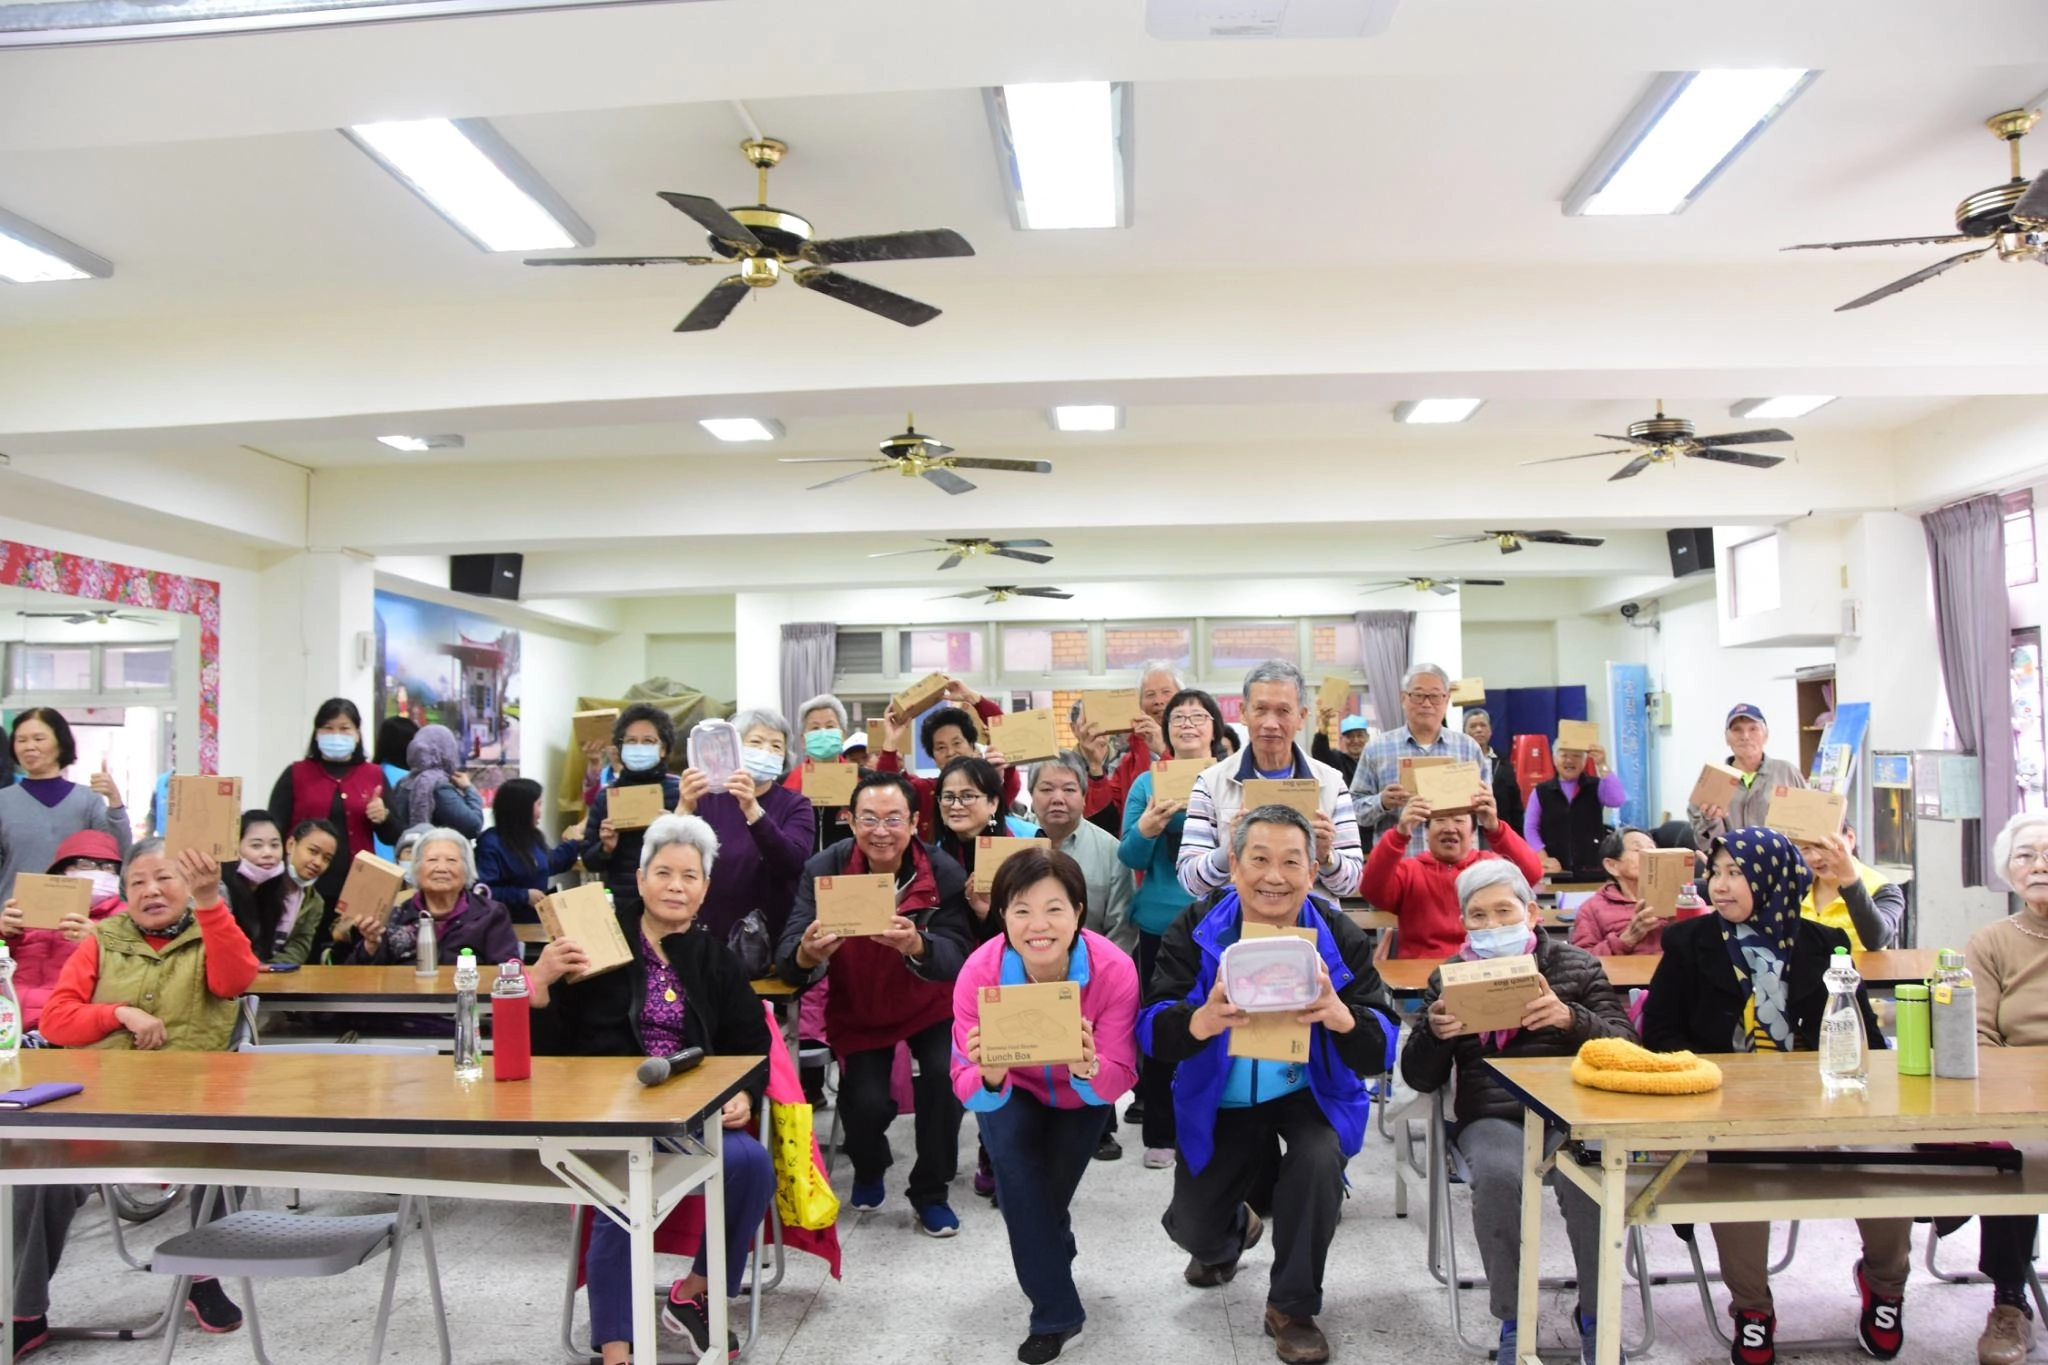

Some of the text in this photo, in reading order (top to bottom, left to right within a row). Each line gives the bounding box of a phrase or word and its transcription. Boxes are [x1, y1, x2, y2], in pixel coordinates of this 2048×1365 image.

[986, 1052, 1031, 1062] Lunch Box
[1874, 1305, 1898, 1330] S
[1743, 1324, 1766, 1347] S
